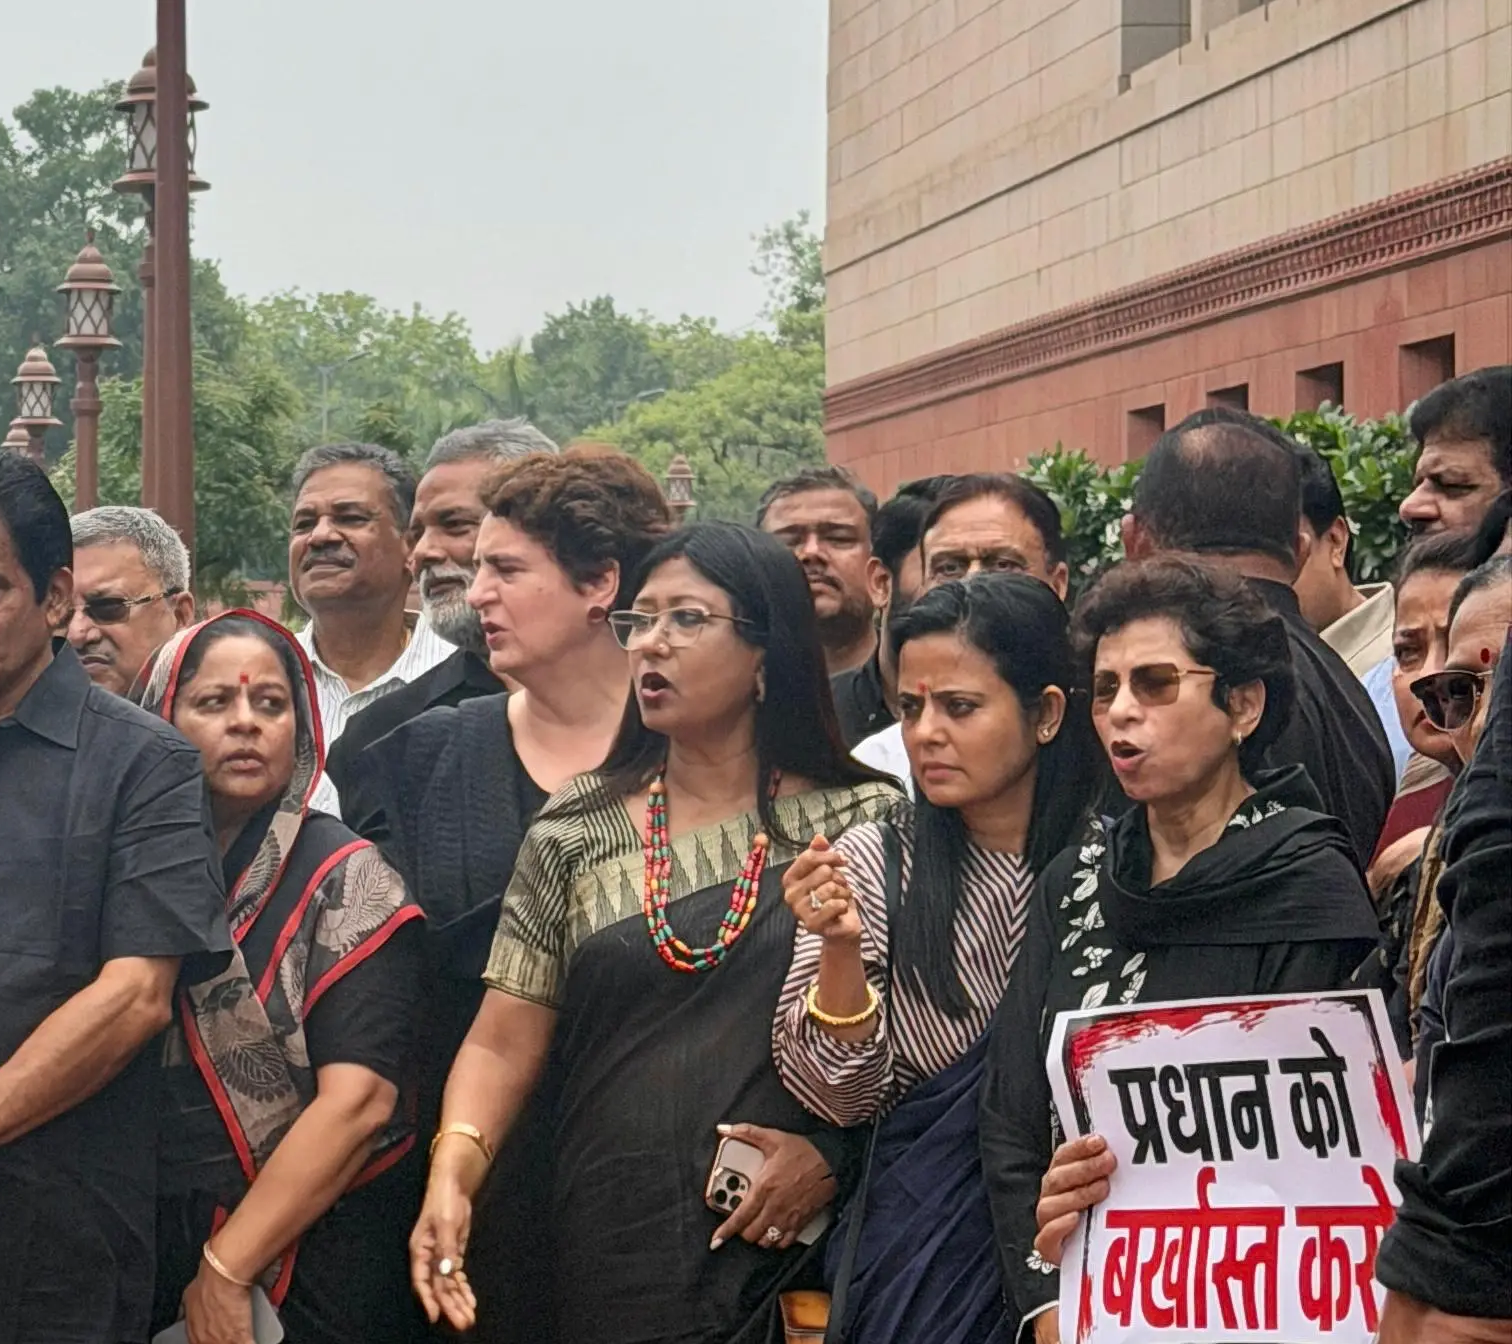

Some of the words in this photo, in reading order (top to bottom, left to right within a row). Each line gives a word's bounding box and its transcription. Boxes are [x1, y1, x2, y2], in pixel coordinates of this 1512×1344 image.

[1108, 1058, 1279, 1164] प्रधान
[1279, 1027, 1362, 1158] को
[1102, 1166, 1285, 1331] बर्खास्त
